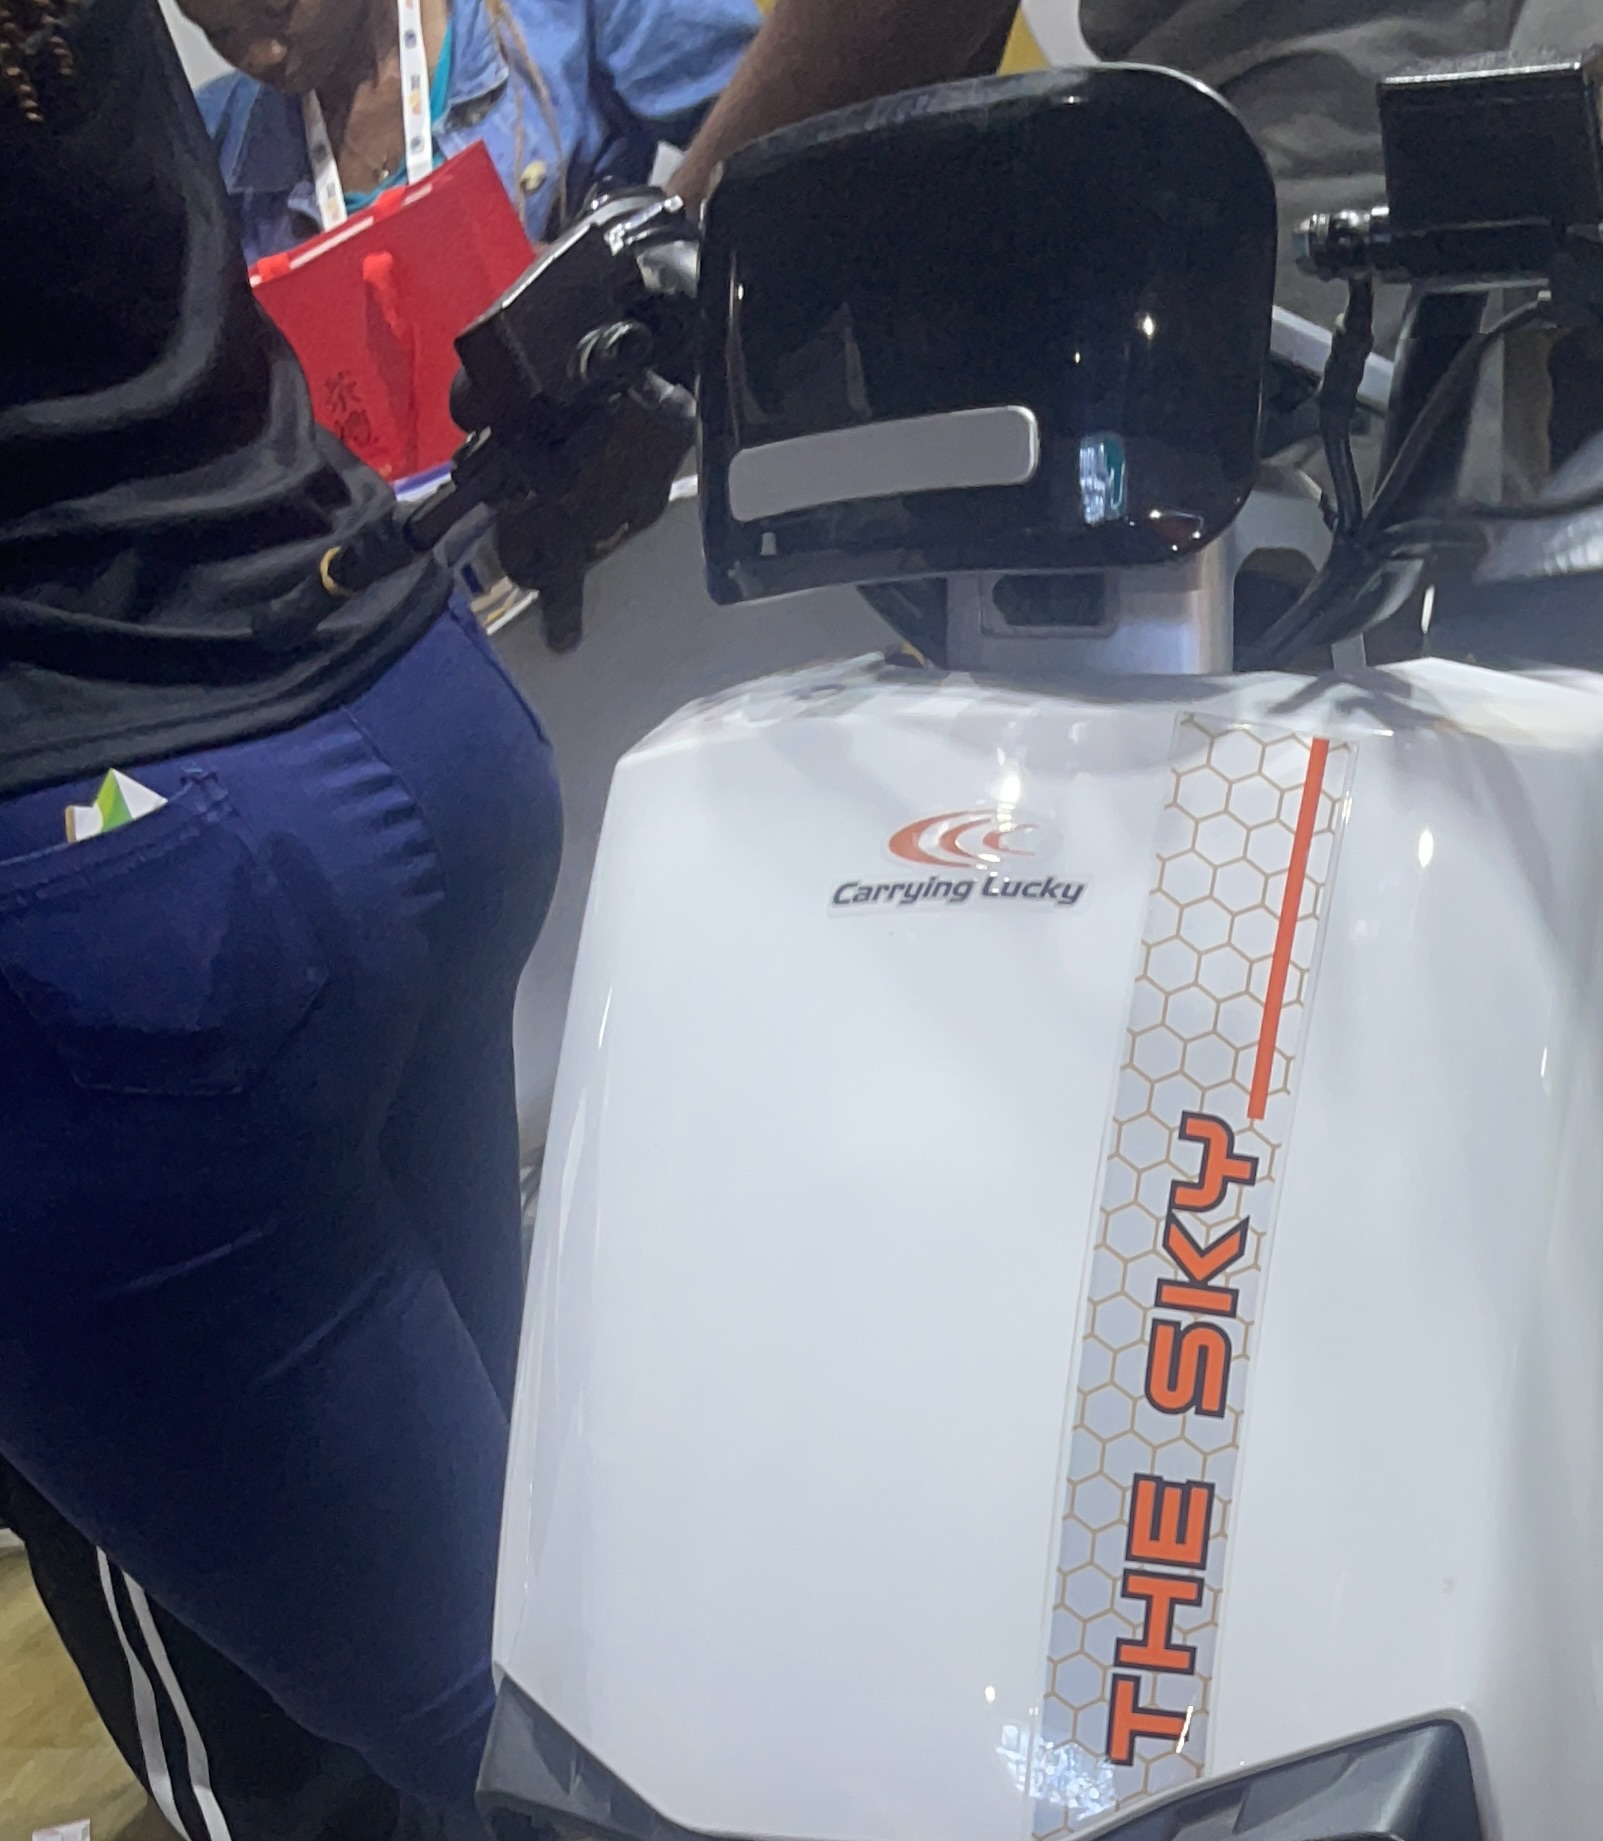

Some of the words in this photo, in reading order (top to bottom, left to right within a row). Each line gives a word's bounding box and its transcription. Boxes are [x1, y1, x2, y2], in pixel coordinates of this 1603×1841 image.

[832, 876, 976, 906] Carrying
[982, 875, 1087, 905] Lucky
[1144, 1111, 1259, 1419] SKY
[1105, 1473, 1217, 1767] THE
